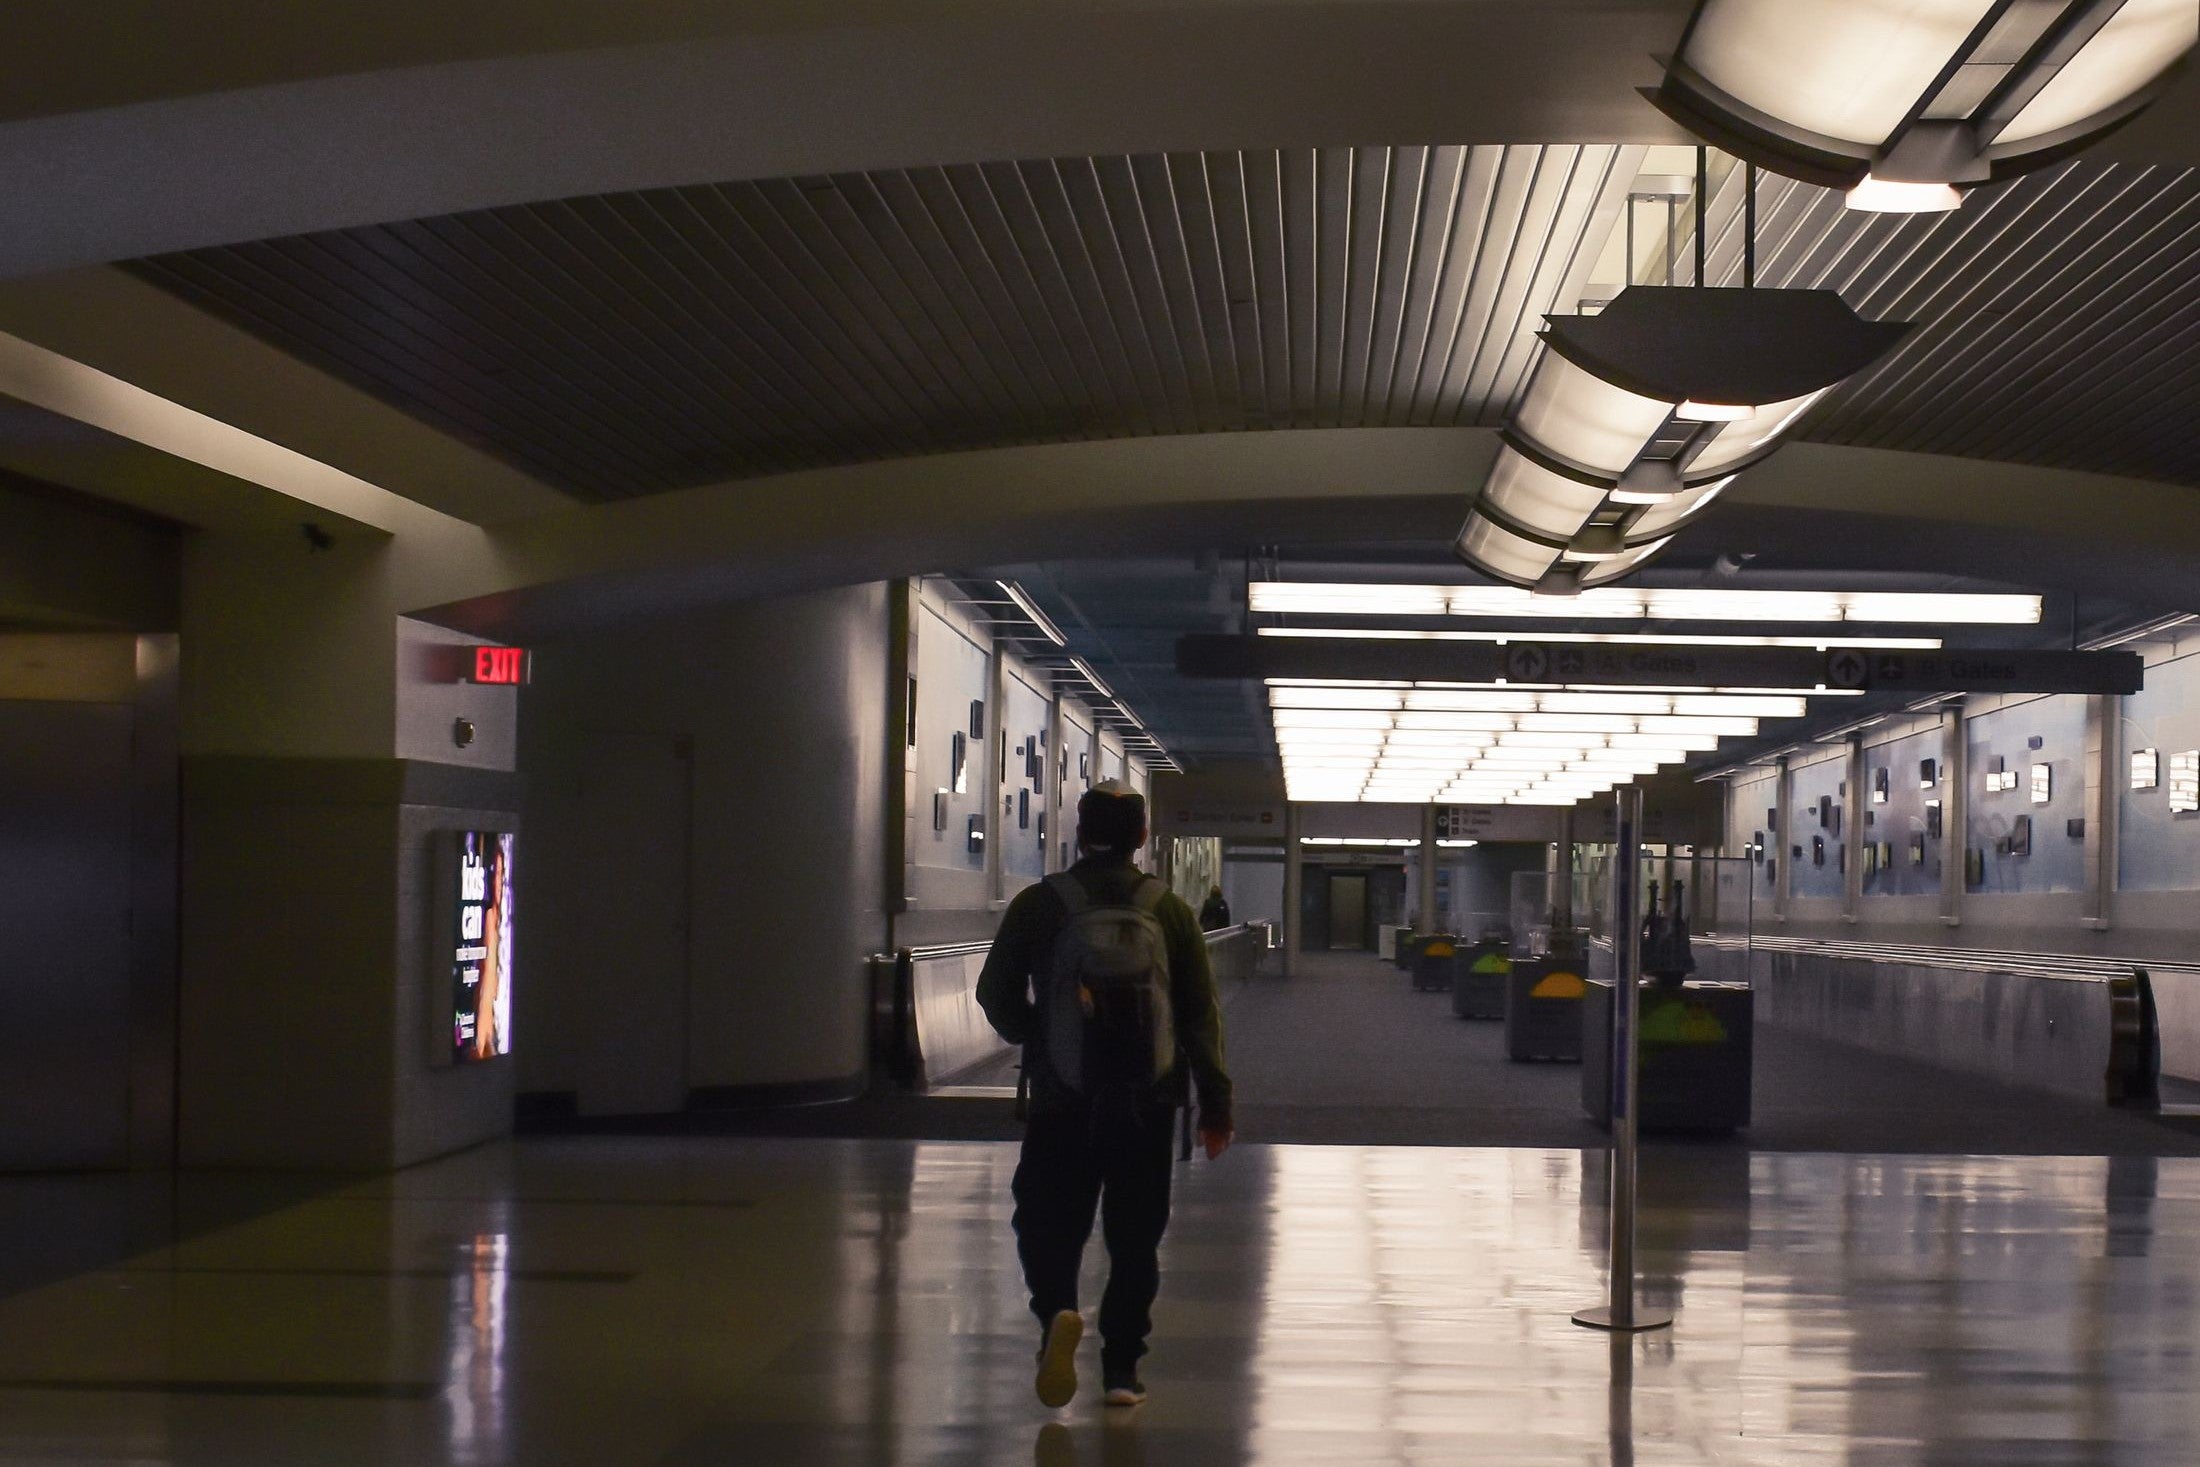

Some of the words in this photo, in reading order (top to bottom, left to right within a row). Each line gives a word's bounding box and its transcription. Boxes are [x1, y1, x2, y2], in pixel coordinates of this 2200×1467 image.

[475, 647, 523, 683] EXIT
[1630, 653, 1697, 674] Gates
[1949, 659, 2016, 680] Gates
[462, 906, 482, 939] can
